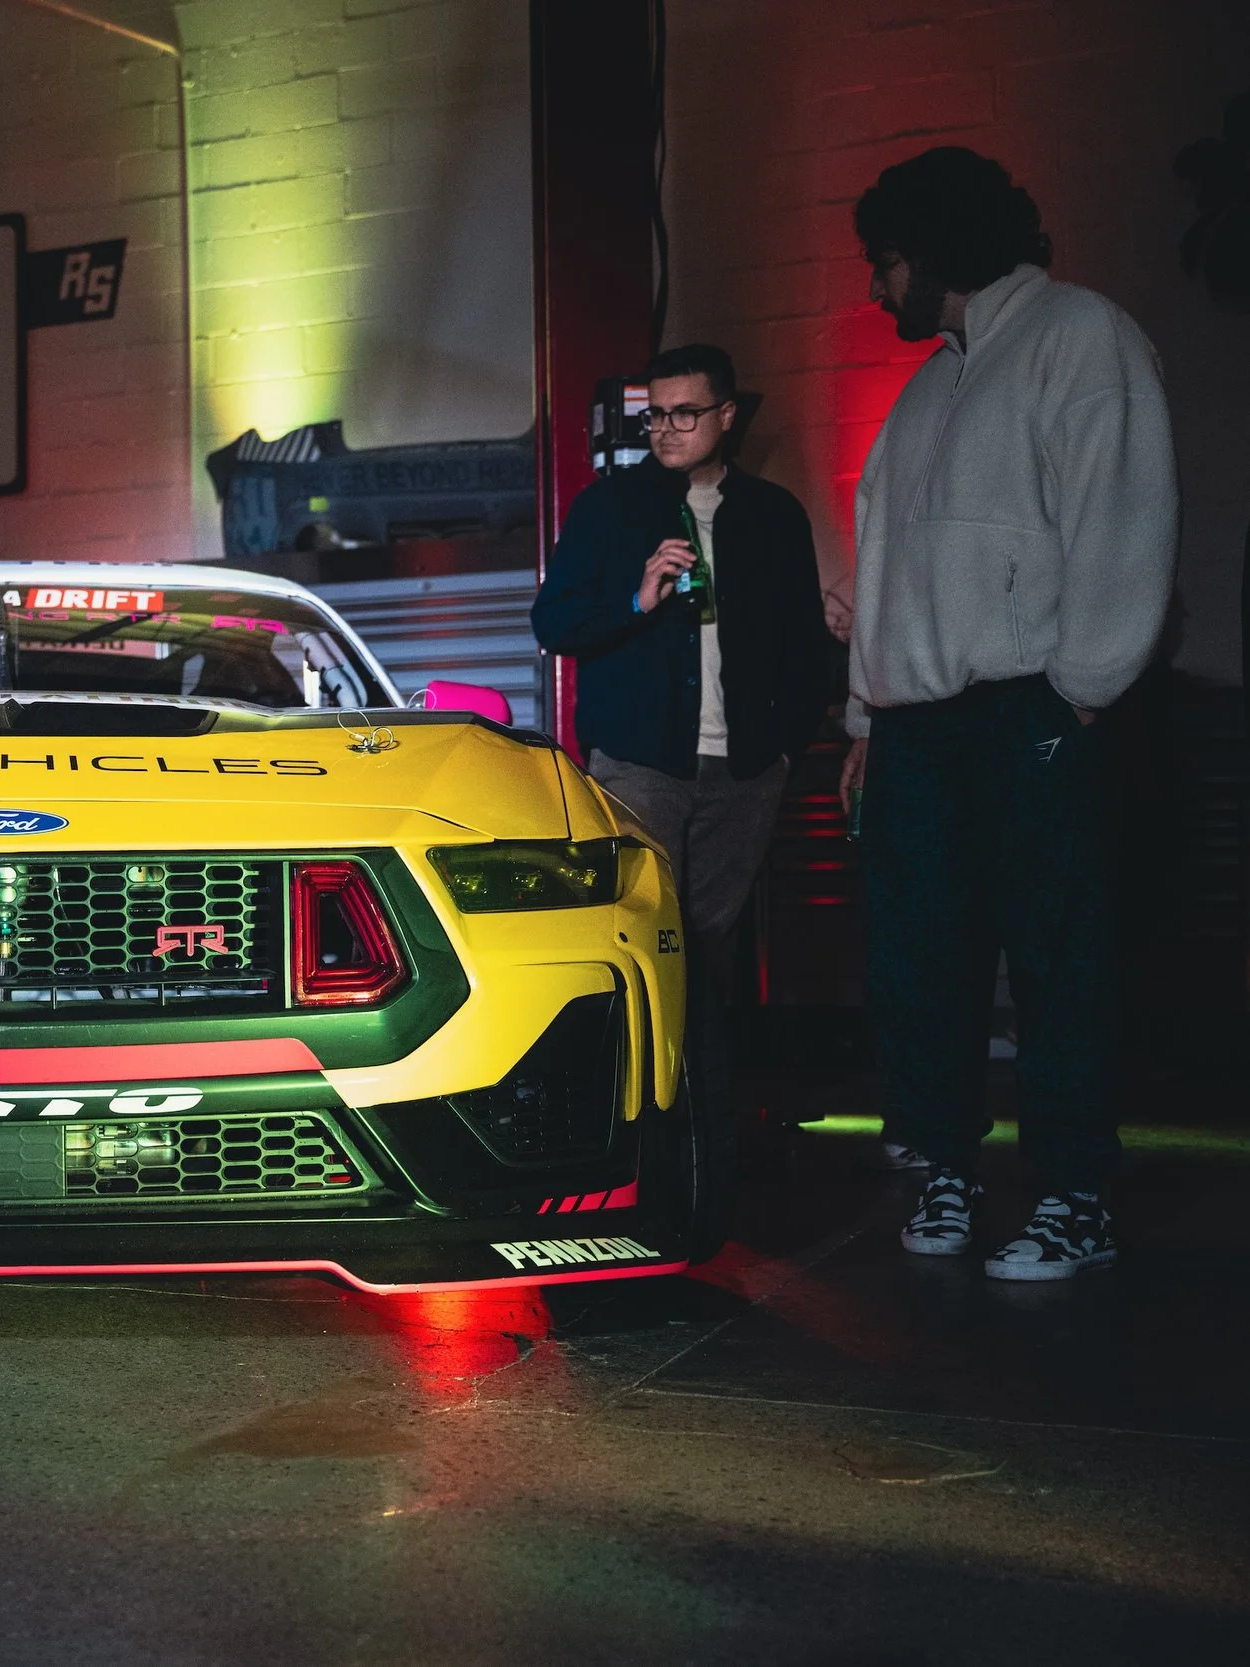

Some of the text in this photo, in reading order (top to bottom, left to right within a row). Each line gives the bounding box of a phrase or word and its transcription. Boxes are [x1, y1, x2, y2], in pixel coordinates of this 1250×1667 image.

[59, 252, 115, 315] RS
[34, 589, 156, 610] DRIFT
[658, 929, 680, 953] BC
[491, 1237, 662, 1270] PENNZOIL
